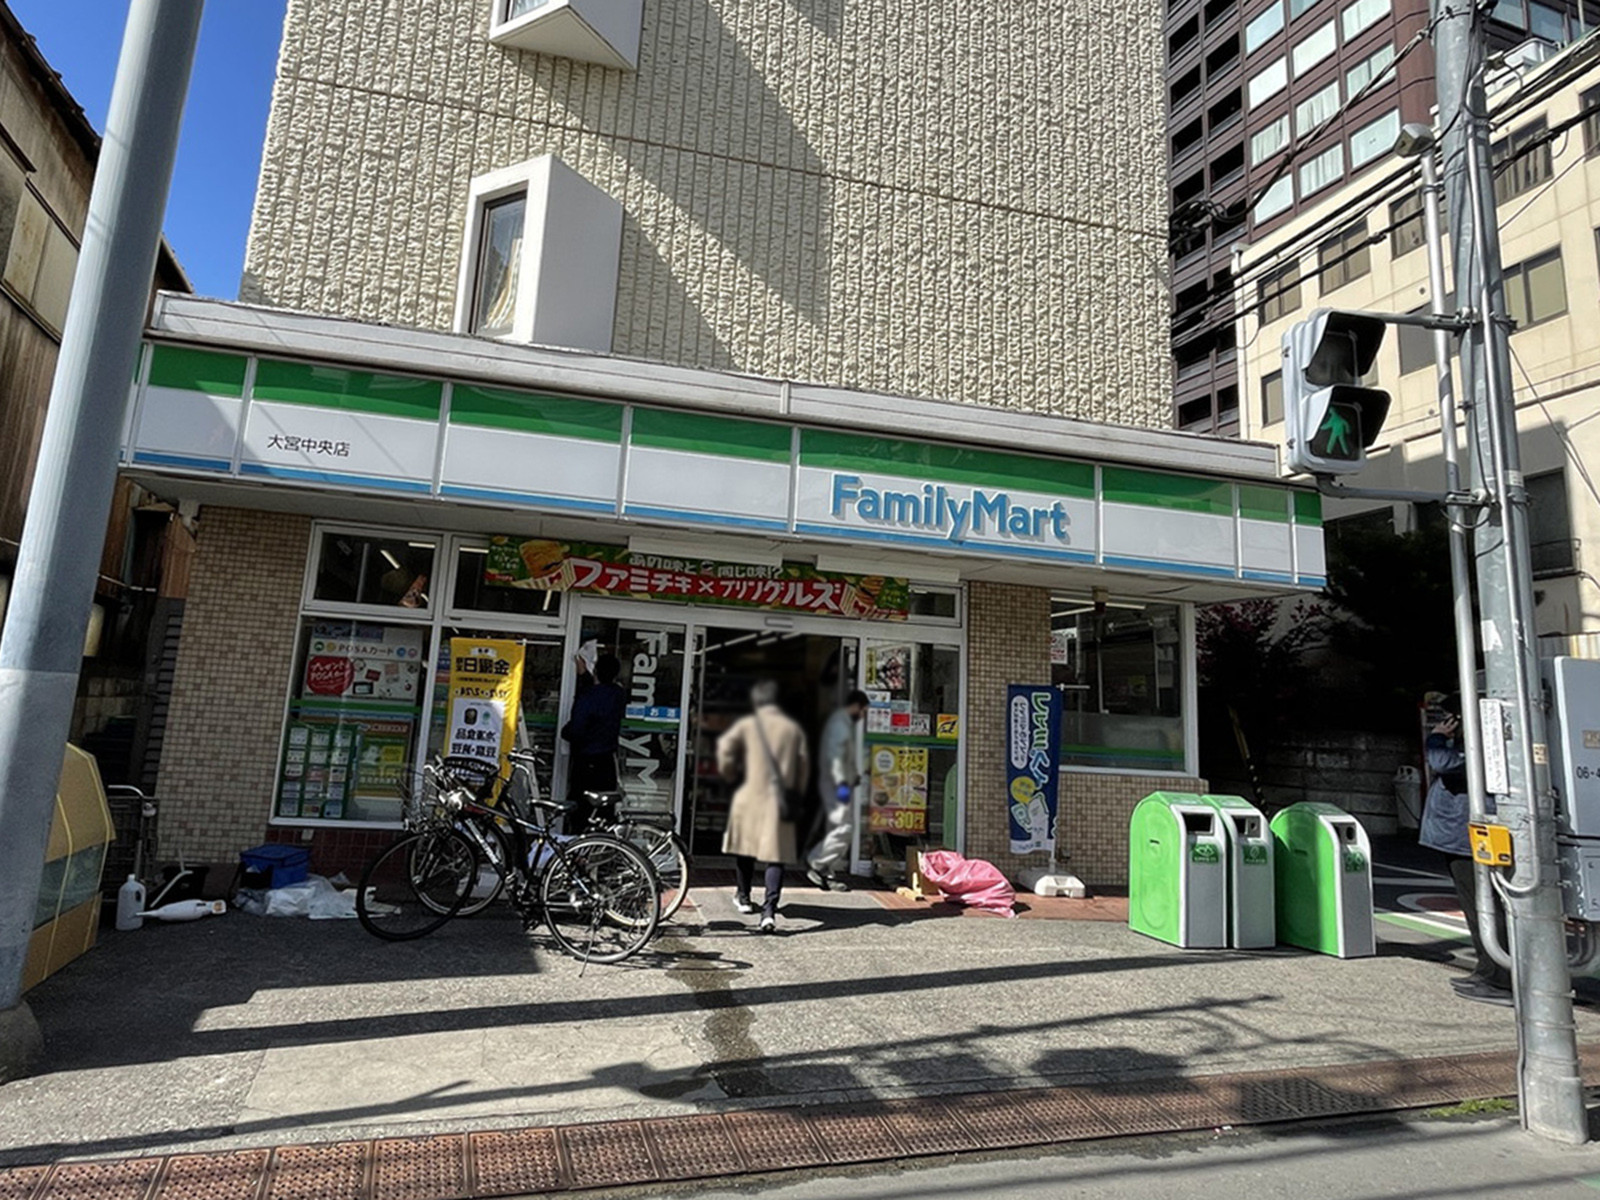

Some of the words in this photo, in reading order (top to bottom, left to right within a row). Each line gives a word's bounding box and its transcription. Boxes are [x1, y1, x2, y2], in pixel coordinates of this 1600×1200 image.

[267, 434, 350, 457] 大宮中央店
[831, 472, 1071, 541] FamilyMart
